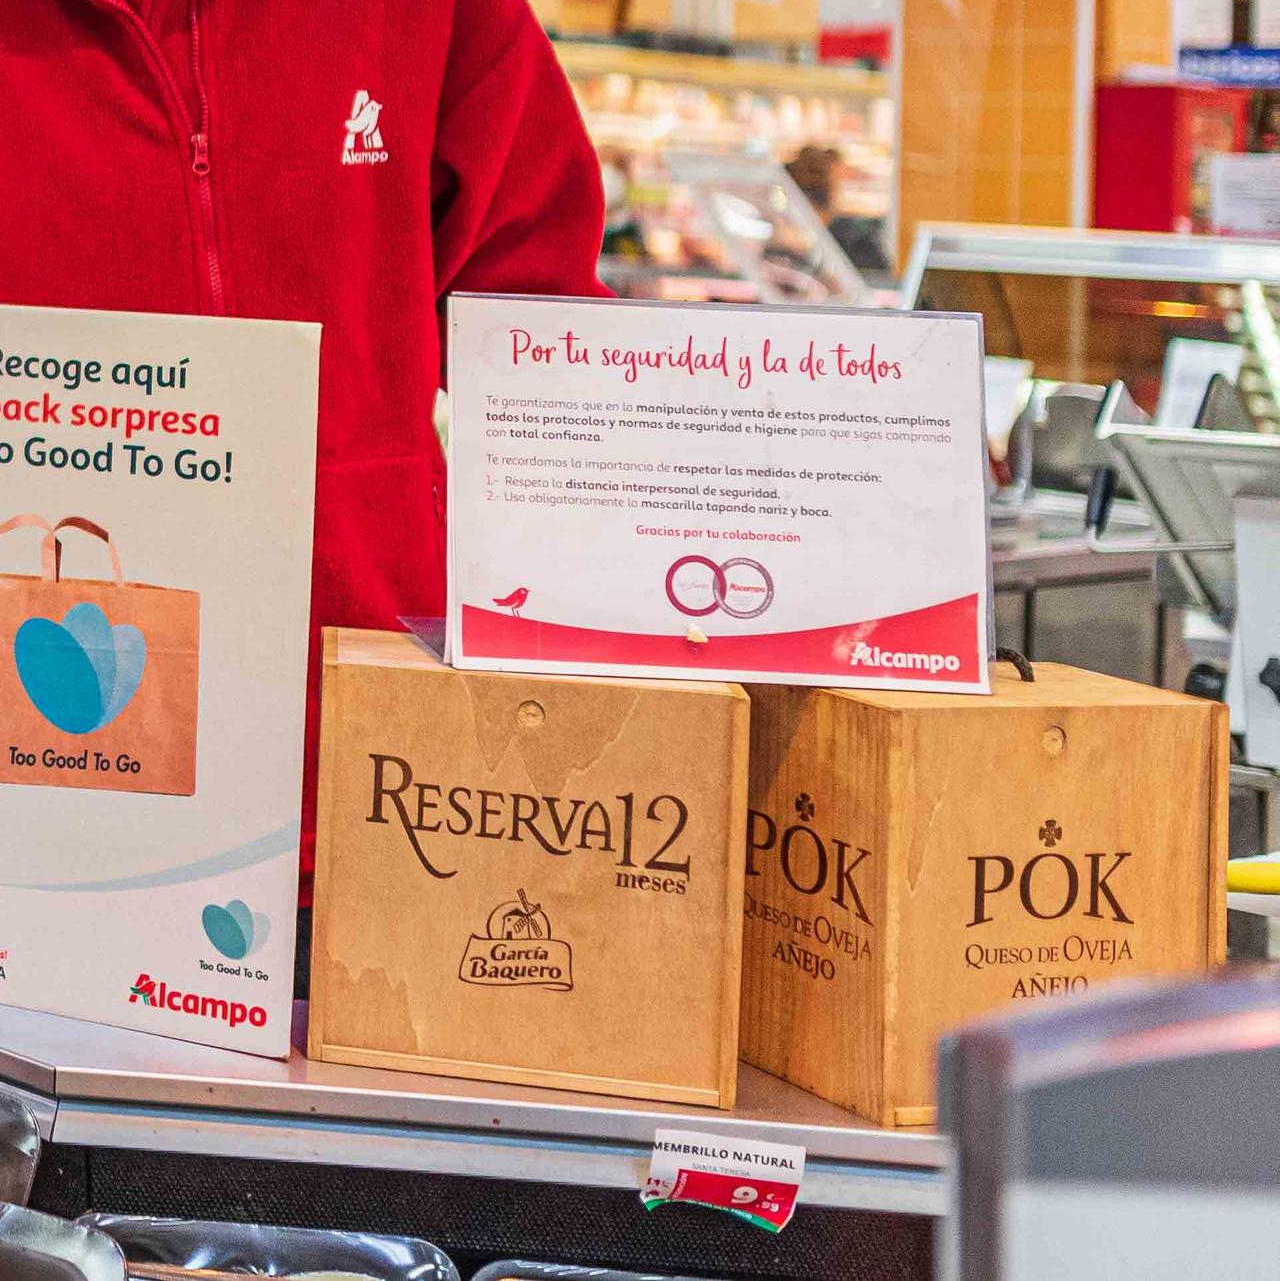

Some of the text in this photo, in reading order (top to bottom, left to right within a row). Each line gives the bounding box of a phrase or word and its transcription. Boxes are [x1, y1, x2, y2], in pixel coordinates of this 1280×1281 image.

[509, 329, 902, 389] Por tu seguridad y la de todos
[111, 358, 190, 395] aquí
[70, 403, 219, 439] sorpresa
[486, 395, 951, 427] Te garantizamos que en la manipulación y venta de estos productos, cumplimos
[486, 412, 952, 444] todos los protocolos y normas de seguridad e higiene para que sigas comprando
[486, 429, 604, 442] con total confianza.
[24, 437, 113, 473] Good
[123, 444, 164, 477] To
[174, 449, 233, 483] Go!
[486, 453, 882, 483] Te recordamos la importancia de respetar las medidas de protección:
[505, 476, 780, 499] Respeta la distancia interpersonal de seguridad.
[504, 492, 832, 518] Usa obligatoriamente la mascarilla tapando nariz y boca.
[636, 525, 801, 543] Gracias por tu colaboración
[729, 583, 766, 593] Alcampo
[850, 641, 960, 674] Alcampo
[9, 746, 141, 774] Too Good To Go
[615, 871, 686, 895] meses
[490, 943, 549, 962] García
[794, 917, 811, 937] DE
[815, 916, 872, 961] OVEJA
[965, 936, 1133, 969] QUESO DE OVEJA
[199, 960, 268, 981] Too Good To Go
[470, 956, 562, 981] Baquero
[773, 941, 835, 980] AÑEJO
[129, 973, 267, 1027] Alcampo
[652, 1141, 795, 1169] MEMBRILLO NATURAL
[692, 1164, 718, 1173] SANTA
